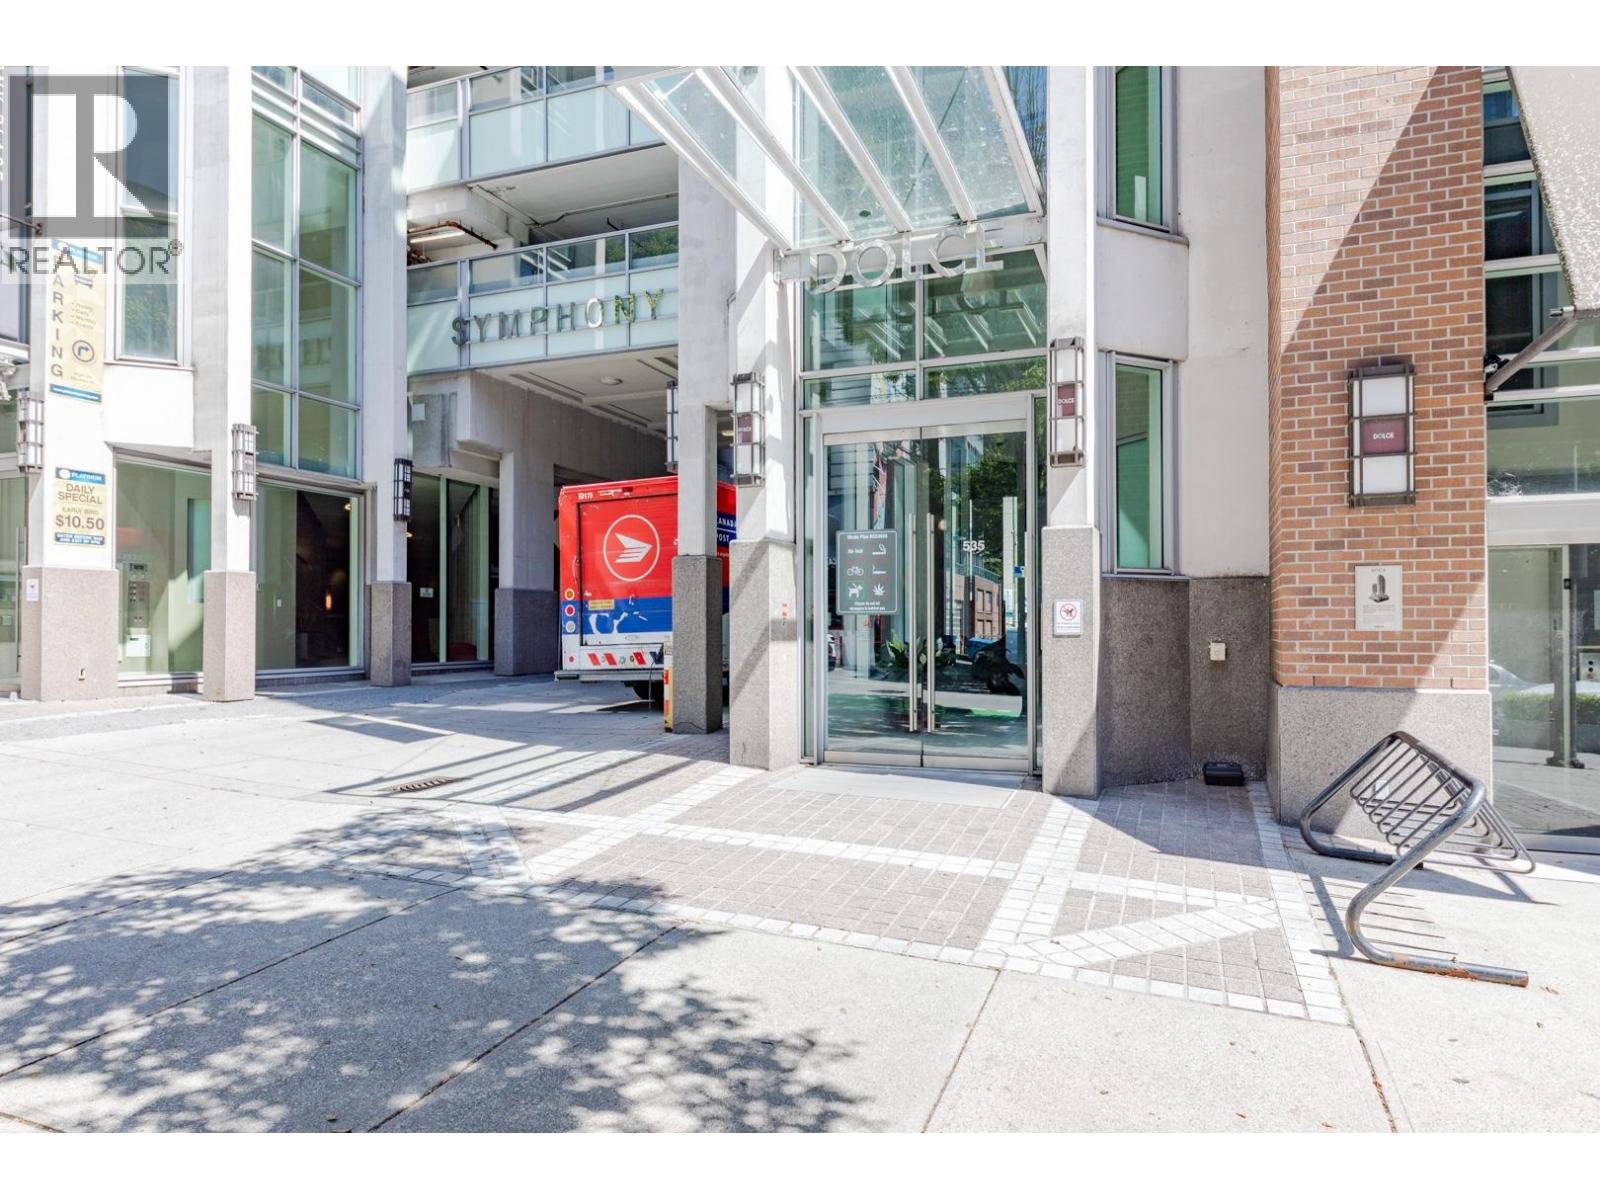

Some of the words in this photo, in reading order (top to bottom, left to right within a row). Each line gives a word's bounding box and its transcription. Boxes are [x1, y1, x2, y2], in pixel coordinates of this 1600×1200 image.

[809, 222, 1004, 295] DOLCE
[451, 288, 664, 346] SYMPHONY
[1373, 432, 1395, 440] DOLCE
[65, 483, 95, 494] DAILY
[57, 491, 103, 505] SPECIAL
[55, 514, 105, 530] $10.50
[963, 540, 986, 551] 535
